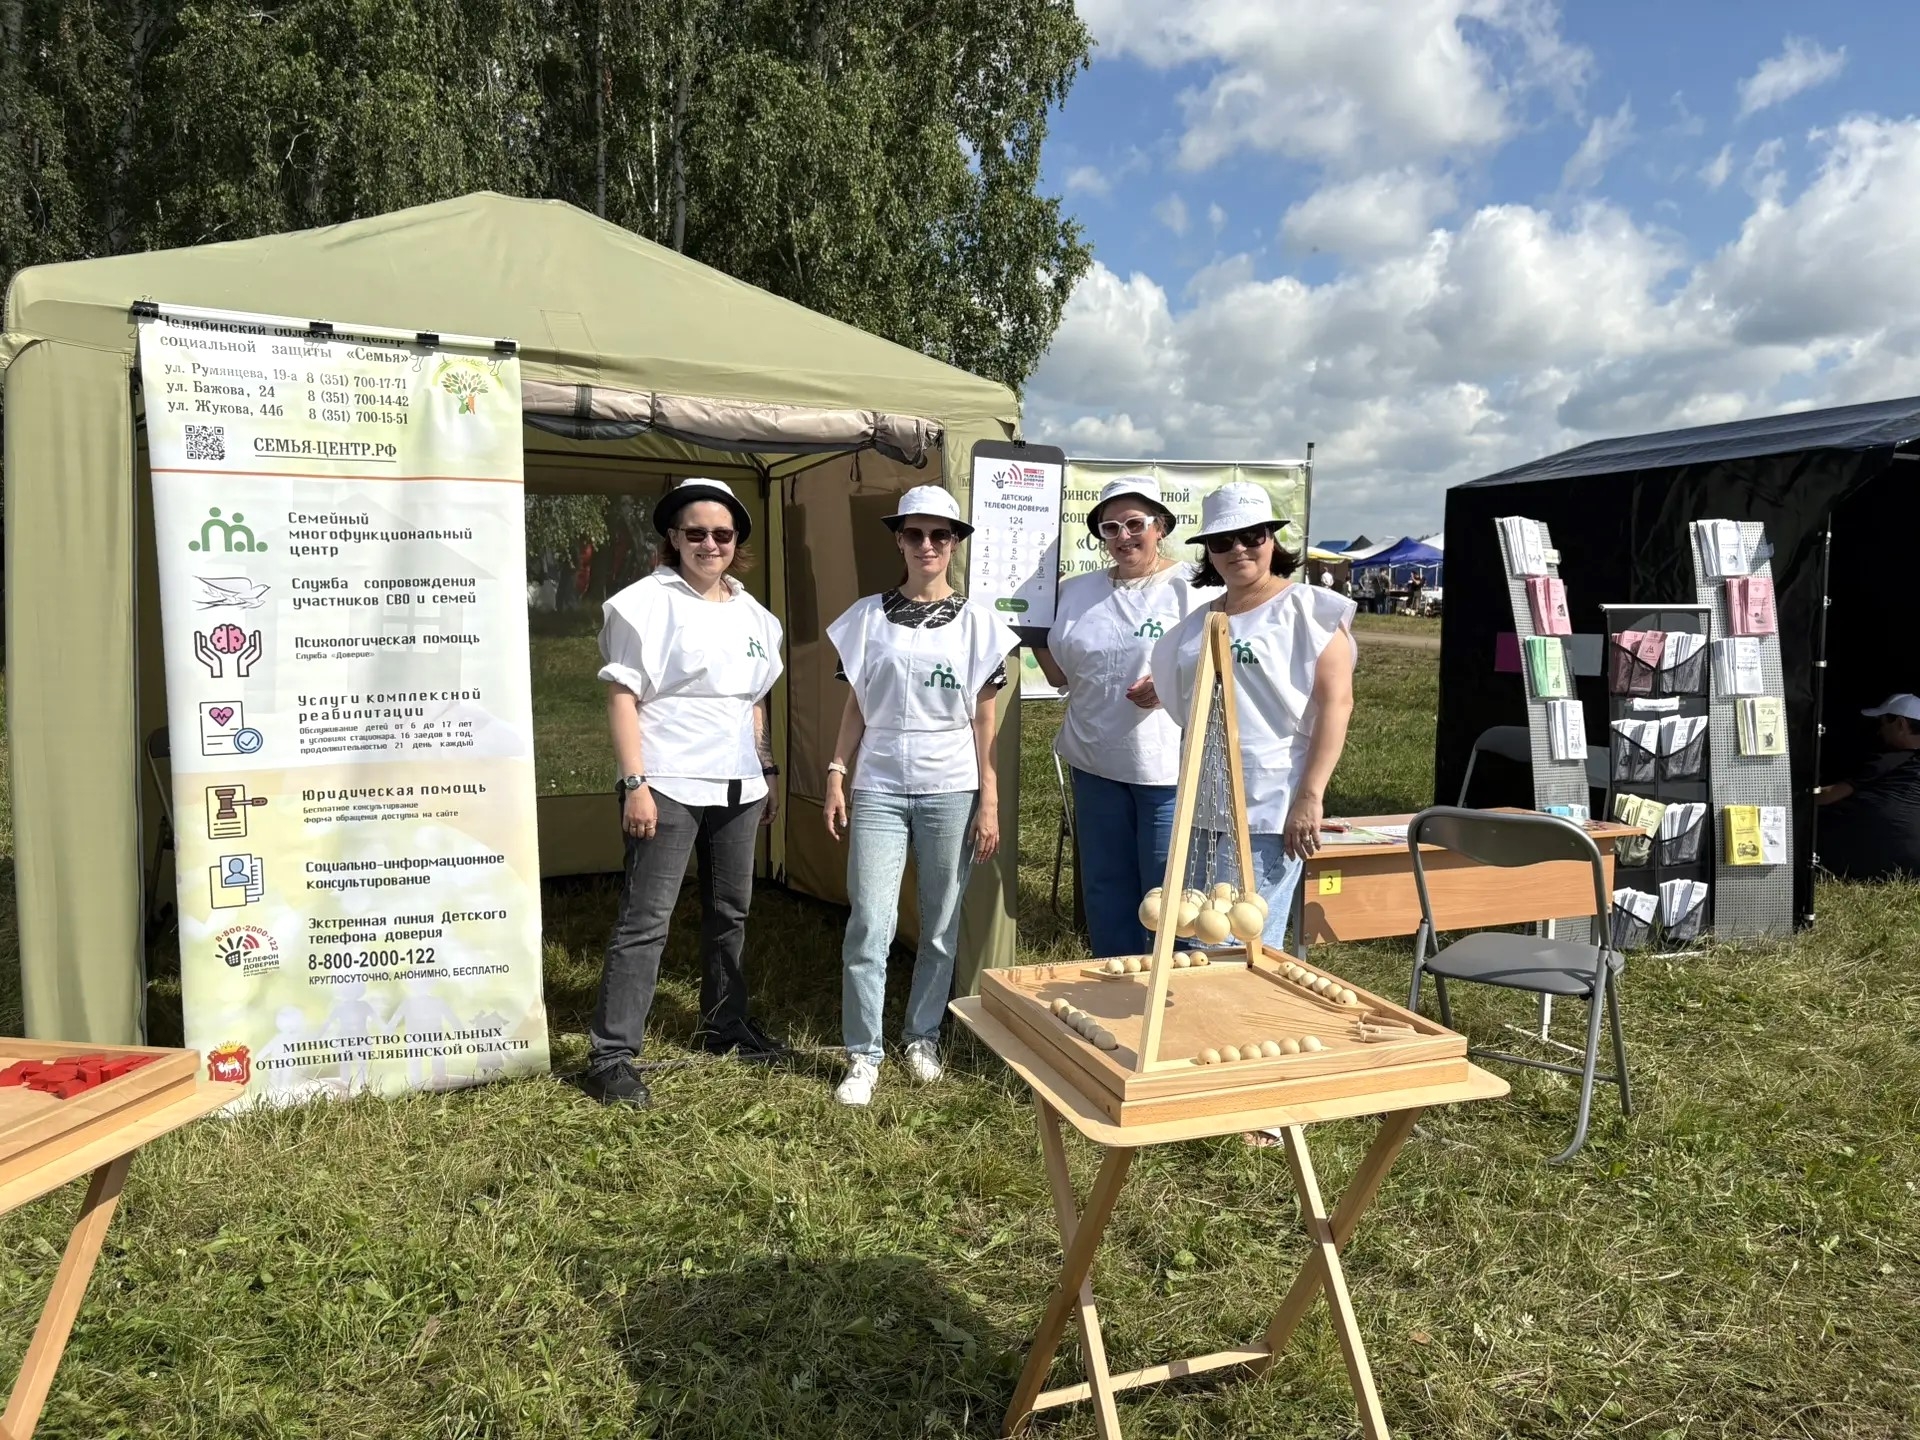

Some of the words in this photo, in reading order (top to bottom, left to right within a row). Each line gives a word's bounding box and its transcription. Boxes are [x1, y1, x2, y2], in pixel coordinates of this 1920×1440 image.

[160, 314, 266, 335] Челябинский
[160, 335, 256, 353] социальной
[272, 345, 332, 359] защиты
[346, 346, 409, 364] «Семья»
[165, 363, 185, 375] ул.
[192, 362, 268, 380] Румянцева,
[273, 368, 298, 382] 19-а
[166, 381, 188, 393] ул.
[193, 380, 250, 398] Бажова,
[259, 384, 276, 398] 24
[306, 372, 314, 384] 8
[320, 373, 349, 387] (351)
[354, 376, 407, 390] 700-17-71
[308, 390, 315, 402] 8
[321, 391, 349, 405] (351)
[354, 394, 409, 407] 700-14-42
[168, 401, 189, 413] ул.
[195, 399, 254, 416] Жукова,
[309, 408, 317, 420] 8
[322, 409, 350, 423] (351)
[356, 411, 409, 425] 700-15-51
[253, 437, 398, 459] СЕМЬЯ-ЦЕНТР.РФ
[984, 501, 1016, 510] ТЕЛЕФОН
[1017, 504, 1049, 512] ДОВЕРИЯ
[1001, 494, 1033, 502] ДЕТСКИЙ
[288, 512, 369, 526] Семейный
[1009, 516, 1023, 524] 124
[289, 529, 472, 543] многофункциональный
[290, 545, 339, 557] центр
[292, 577, 348, 592] Служба
[364, 577, 476, 590] сопровождения
[293, 595, 379, 609] участников
[386, 594, 410, 605] СВО
[417, 595, 425, 604] и
[432, 592, 476, 604] семей
[295, 634, 416, 649] Психологическая
[423, 633, 480, 646] помощь
[296, 652, 327, 661] Служба
[331, 651, 375, 660] «Доверие»
[298, 694, 359, 708] Услуги
[367, 688, 480, 704] комплексной
[299, 706, 424, 724] реабилитации
[300, 725, 358, 735] Обслуживание
[365, 723, 388, 732] детей
[300, 743, 387, 754] продолжительностью
[412, 742, 432, 750] день
[440, 739, 473, 748] каждый
[309, 736, 346, 745] условиях
[302, 785, 414, 802] Юридическая
[420, 783, 487, 796] помощь
[303, 804, 350, 814] Бесплатное
[335, 813, 378, 823] обращения
[381, 812, 418, 822] доступна
[435, 810, 459, 818] сайте
[306, 853, 505, 874] Социально-информационное
[306, 873, 431, 891] консультирование
[1326, 875, 1333, 890] 3
[308, 915, 386, 930] Экстренная
[394, 913, 434, 925] линия
[441, 909, 507, 924] Детского
[309, 932, 376, 945] телефона
[385, 928, 442, 943] доверия
[243, 954, 279, 964] ТЕЛЕФОН
[243, 960, 280, 971] ДОВЕРИЯ
[308, 948, 435, 970] 8-800-2000-122
[309, 972, 391, 985] КРУГЛОСУТОЧНО,
[394, 968, 450, 980] АНОНИМНО,
[453, 964, 509, 977] БЕСПЛАТНО
[283, 1034, 400, 1053] МИНИСТЕРСТВО
[403, 1027, 502, 1044] СОЦИАЛЬНЫХ
[255, 1049, 353, 1071] ОТНОШЕНИЙ
[357, 1042, 463, 1061] ЧЕЛЯБИНСКОЙ
[466, 1039, 529, 1054] ОБЛАСТИ
